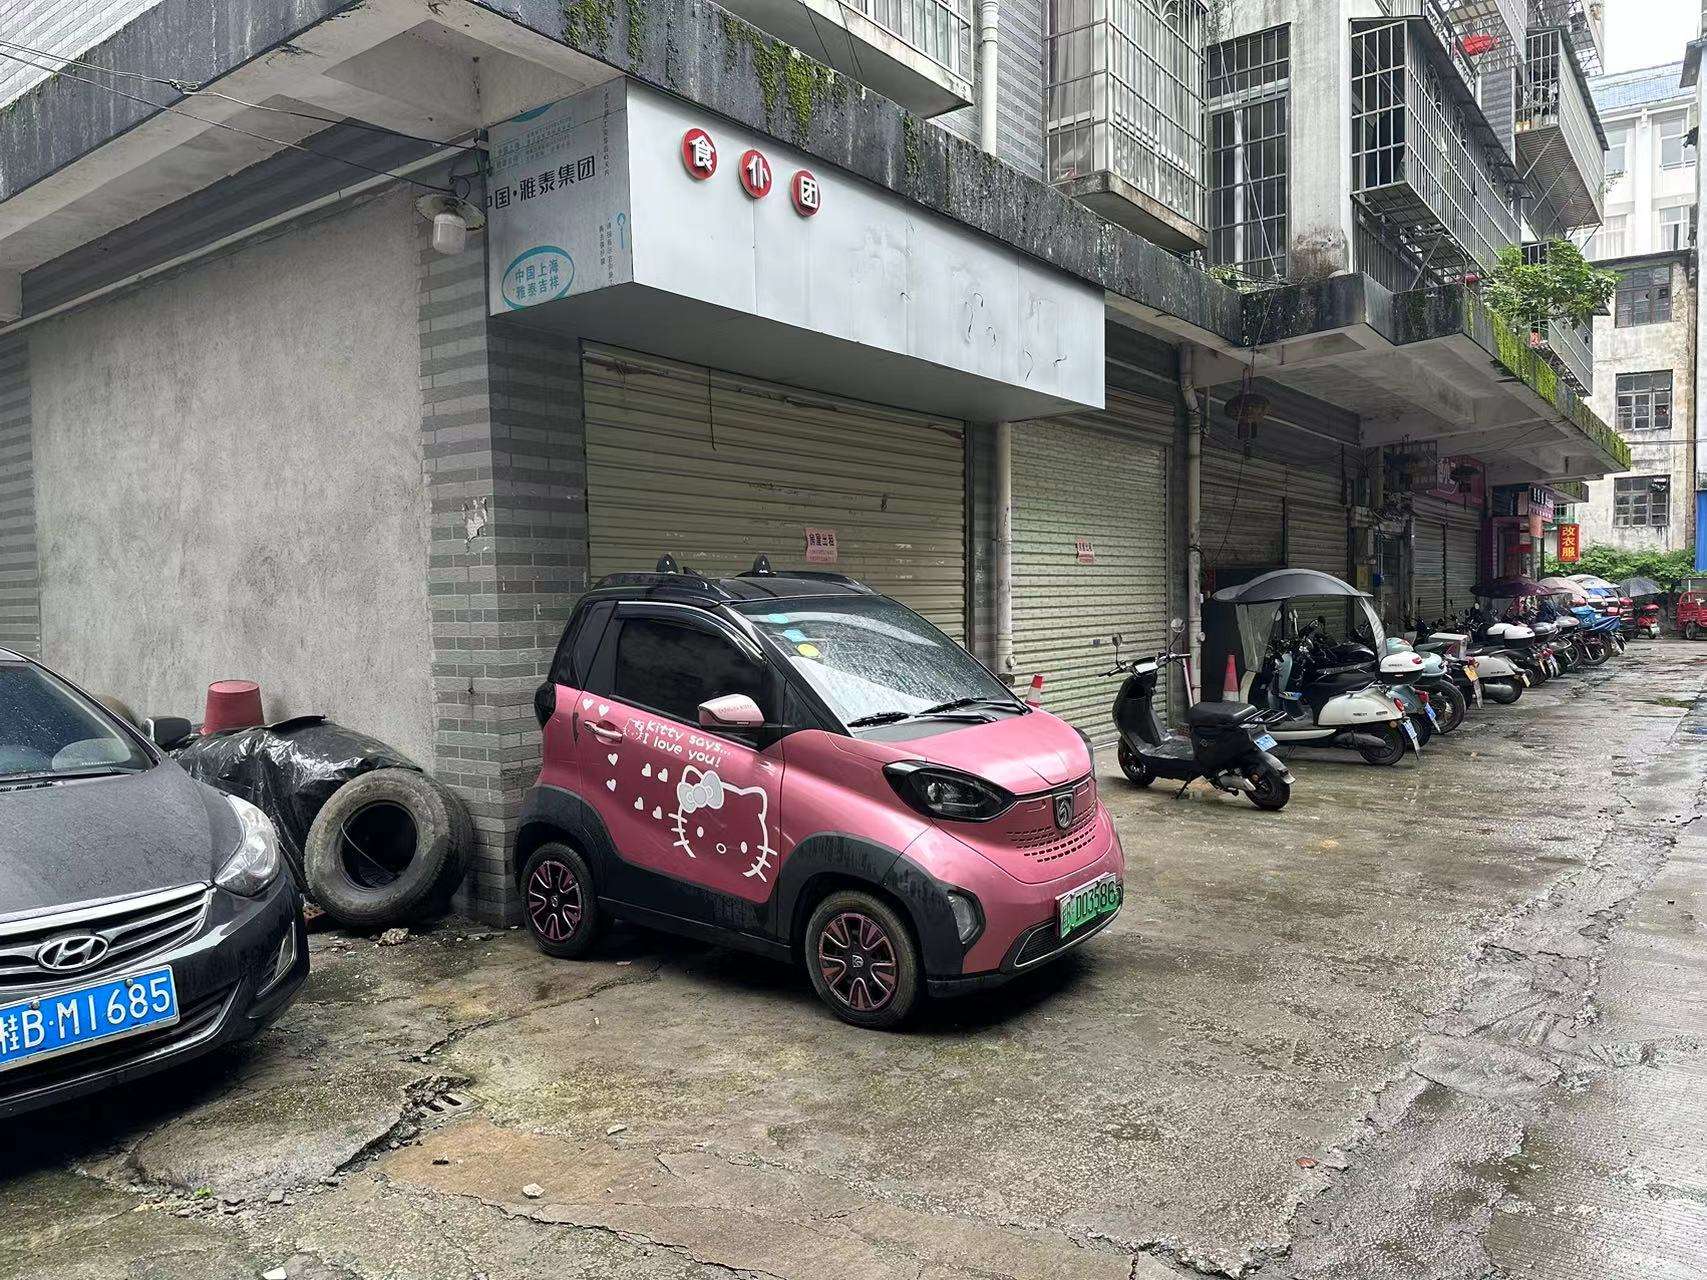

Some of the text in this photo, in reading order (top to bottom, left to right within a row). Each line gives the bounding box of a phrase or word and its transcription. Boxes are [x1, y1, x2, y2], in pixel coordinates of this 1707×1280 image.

[687, 134, 819, 209] 食仆团
[515, 257, 559, 283] 中国上海
[515, 276, 560, 300] 雅泰吉祥
[1561, 526, 1576, 558] 改衣服
[643, 732, 722, 769] I love you!
